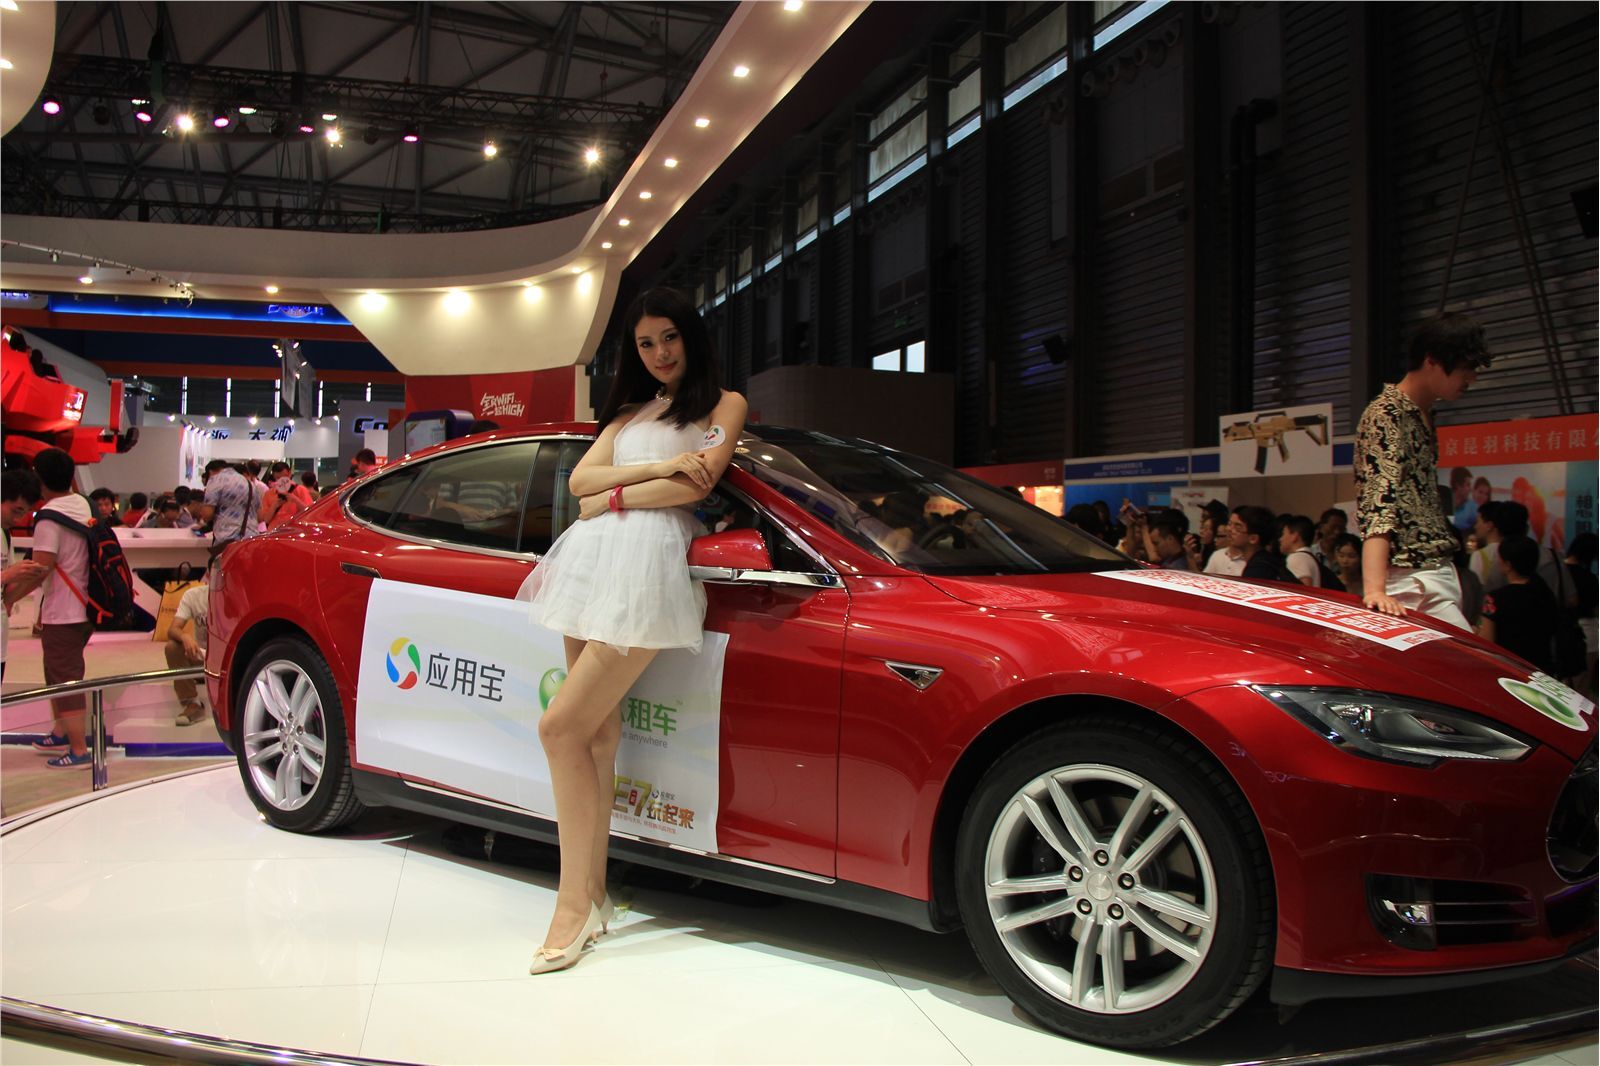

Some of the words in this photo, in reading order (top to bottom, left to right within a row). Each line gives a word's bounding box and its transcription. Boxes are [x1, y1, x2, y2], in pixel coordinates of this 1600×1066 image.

[425, 652, 506, 702] 应用宝
[621, 697, 677, 736] 租车
[628, 732, 668, 748] anywhere
